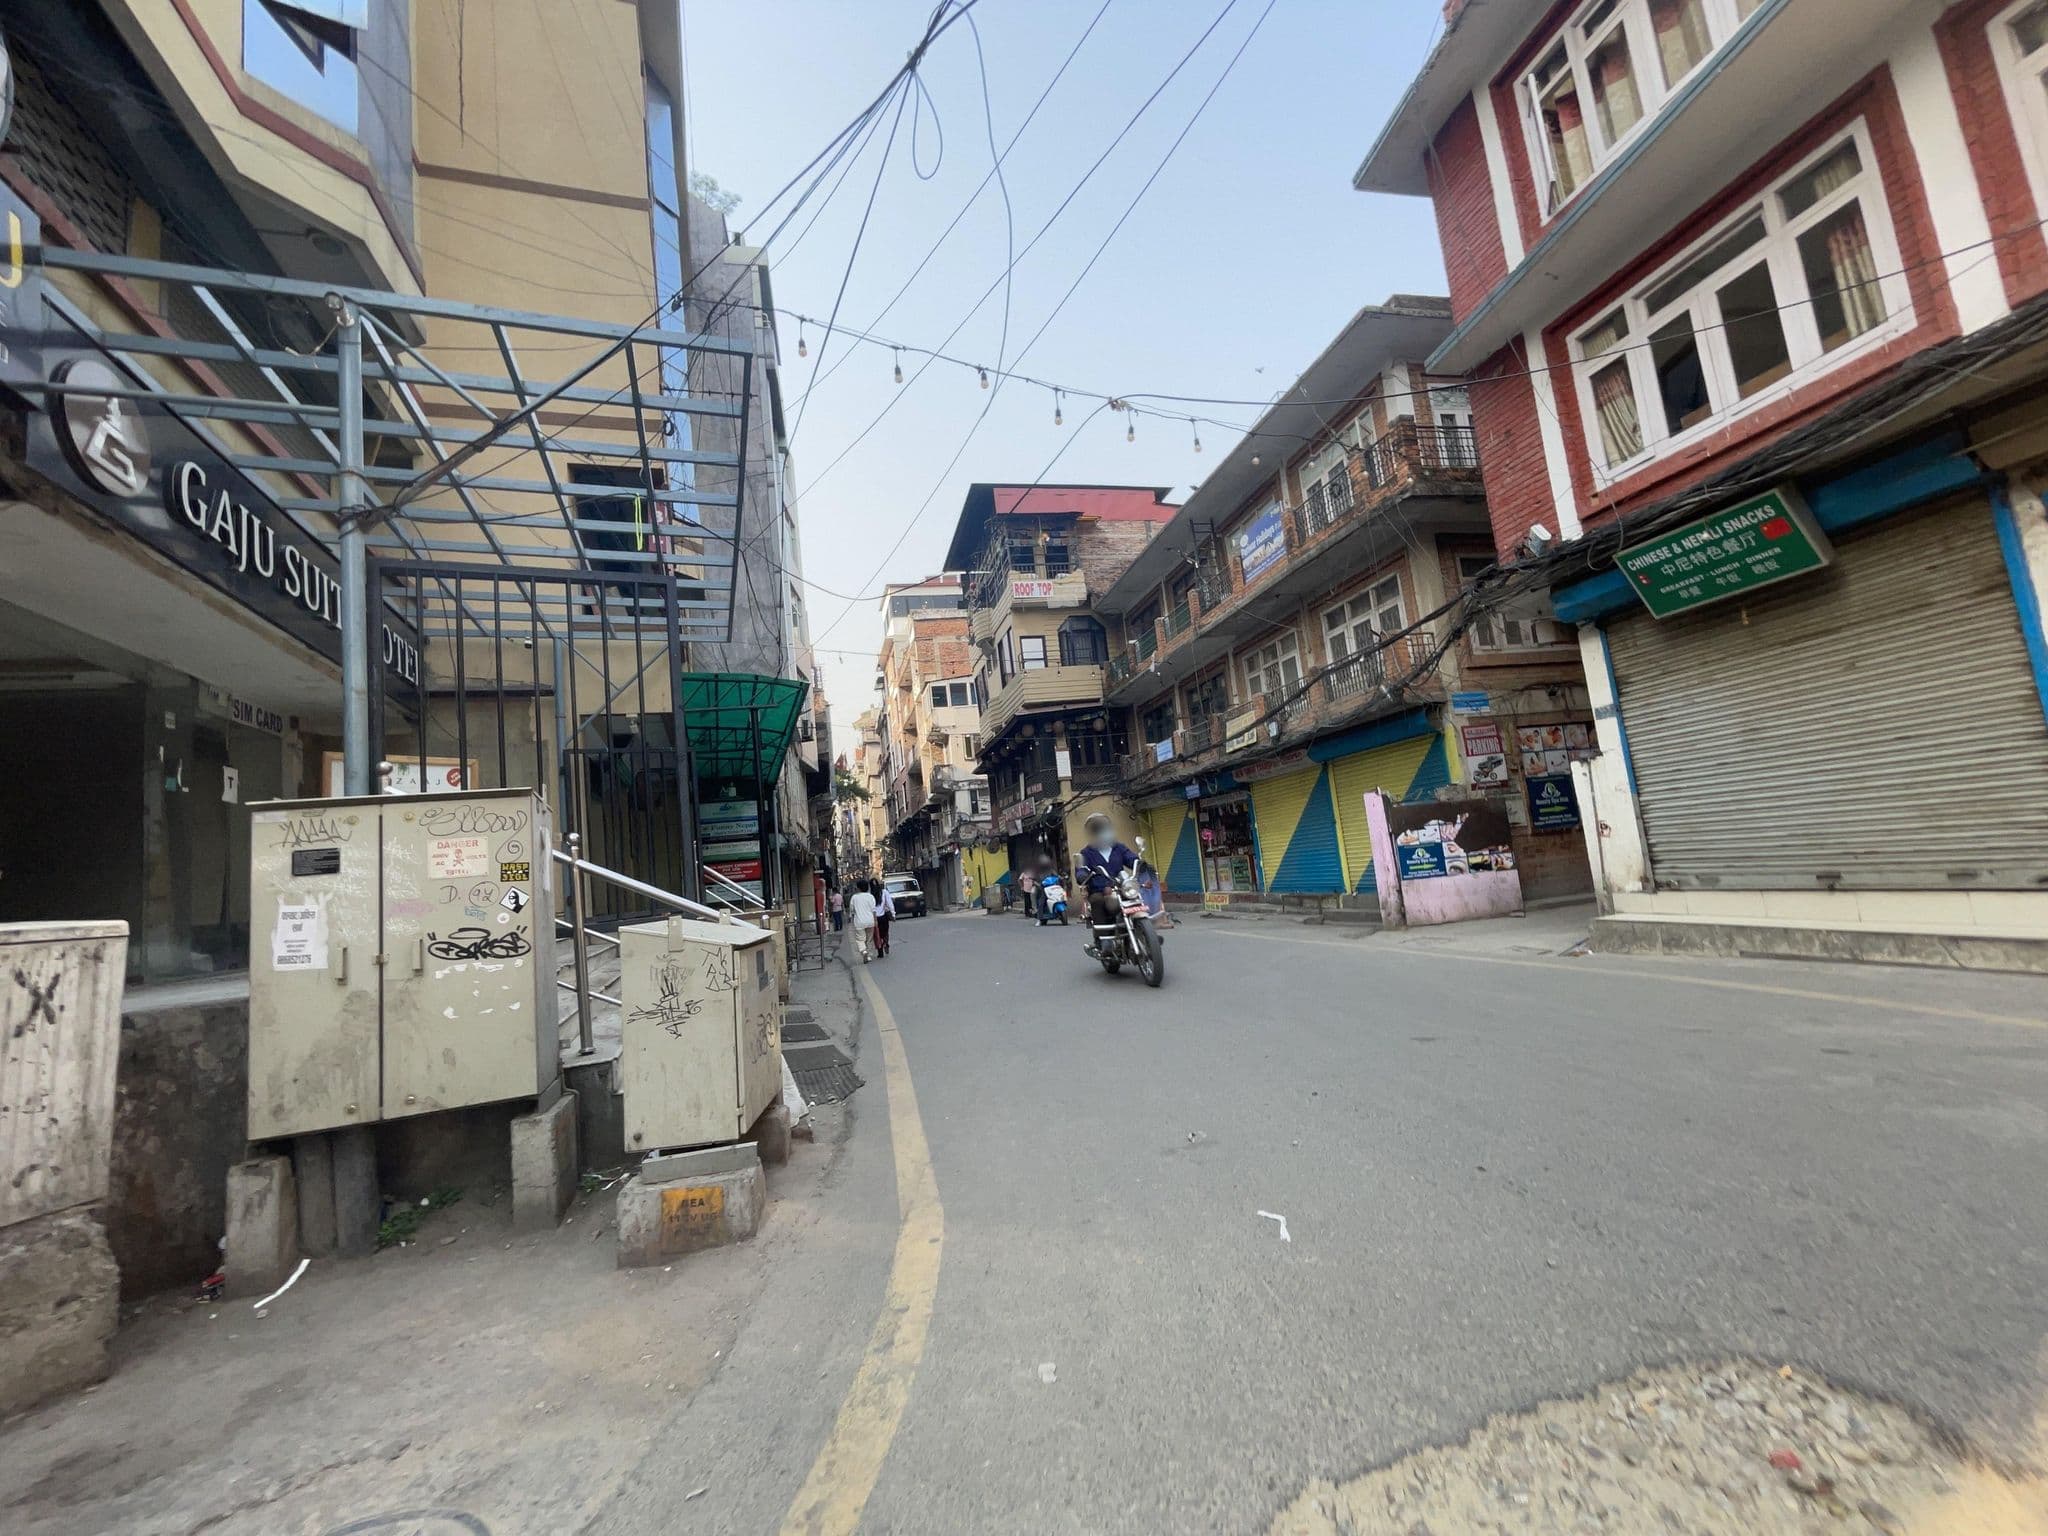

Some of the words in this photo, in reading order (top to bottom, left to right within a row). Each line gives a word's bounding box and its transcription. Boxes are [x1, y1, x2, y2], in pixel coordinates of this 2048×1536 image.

[1627, 546, 1672, 571] CHINESE
[1672, 542, 1683, 554] &
[1723, 505, 1776, 533] SNACKS
[180, 461, 275, 578] GAJU
[285, 545, 342, 631] SUIT
[383, 624, 419, 686] OTEL
[1660, 575, 1705, 594] BREAKFAST
[1710, 562, 1740, 577] LUNCH
[1746, 547, 1782, 564] DINNER
[1014, 582, 1034, 596] ROOF
[1037, 582, 1053, 596] TOP
[233, 699, 253, 723] SIM
[256, 708, 282, 733] CARD
[1467, 736, 1501, 756] PARKING
[437, 839, 479, 849] DANGER
